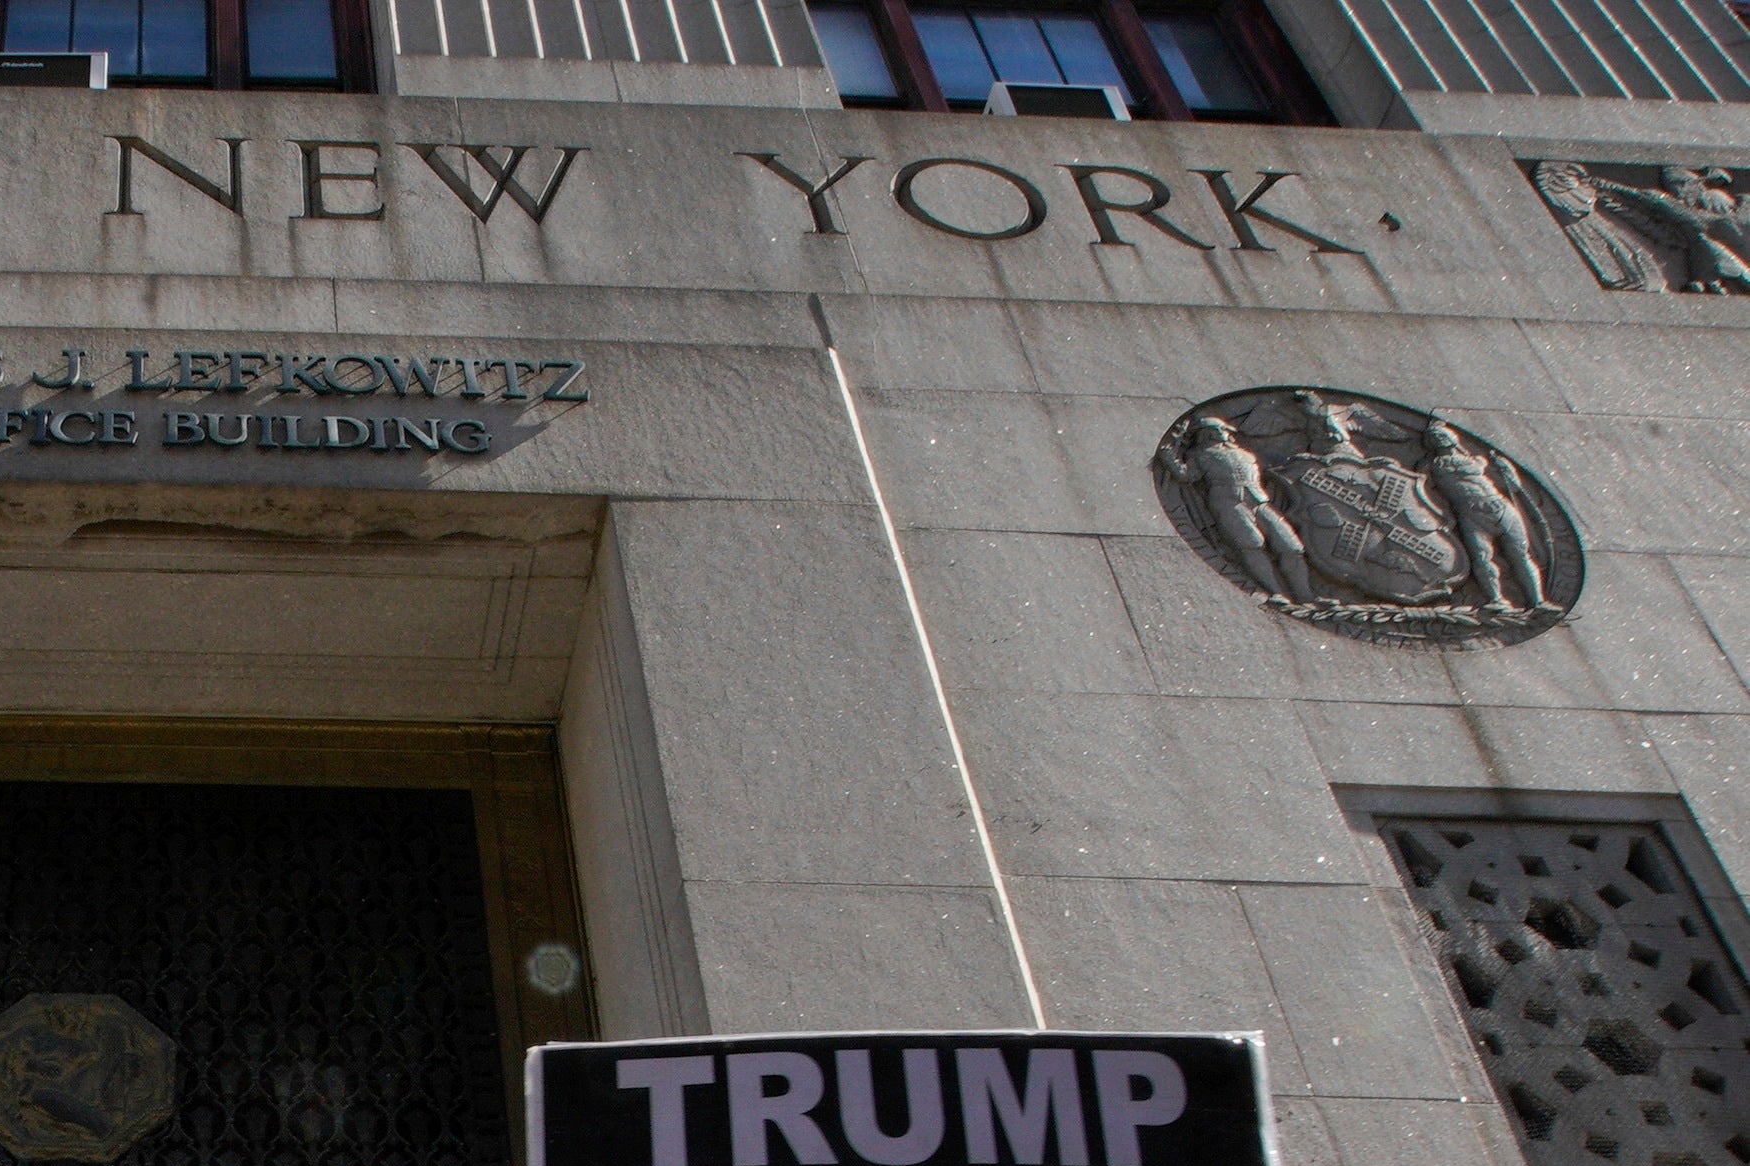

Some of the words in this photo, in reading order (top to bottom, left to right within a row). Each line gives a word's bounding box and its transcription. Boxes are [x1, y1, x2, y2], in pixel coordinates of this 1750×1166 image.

[104, 134, 591, 225] NEW
[735, 151, 1365, 256] YORK
[33, 347, 96, 390] J.
[124, 349, 591, 402] LEFKOWITZ
[162, 410, 494, 454] BUILDING
